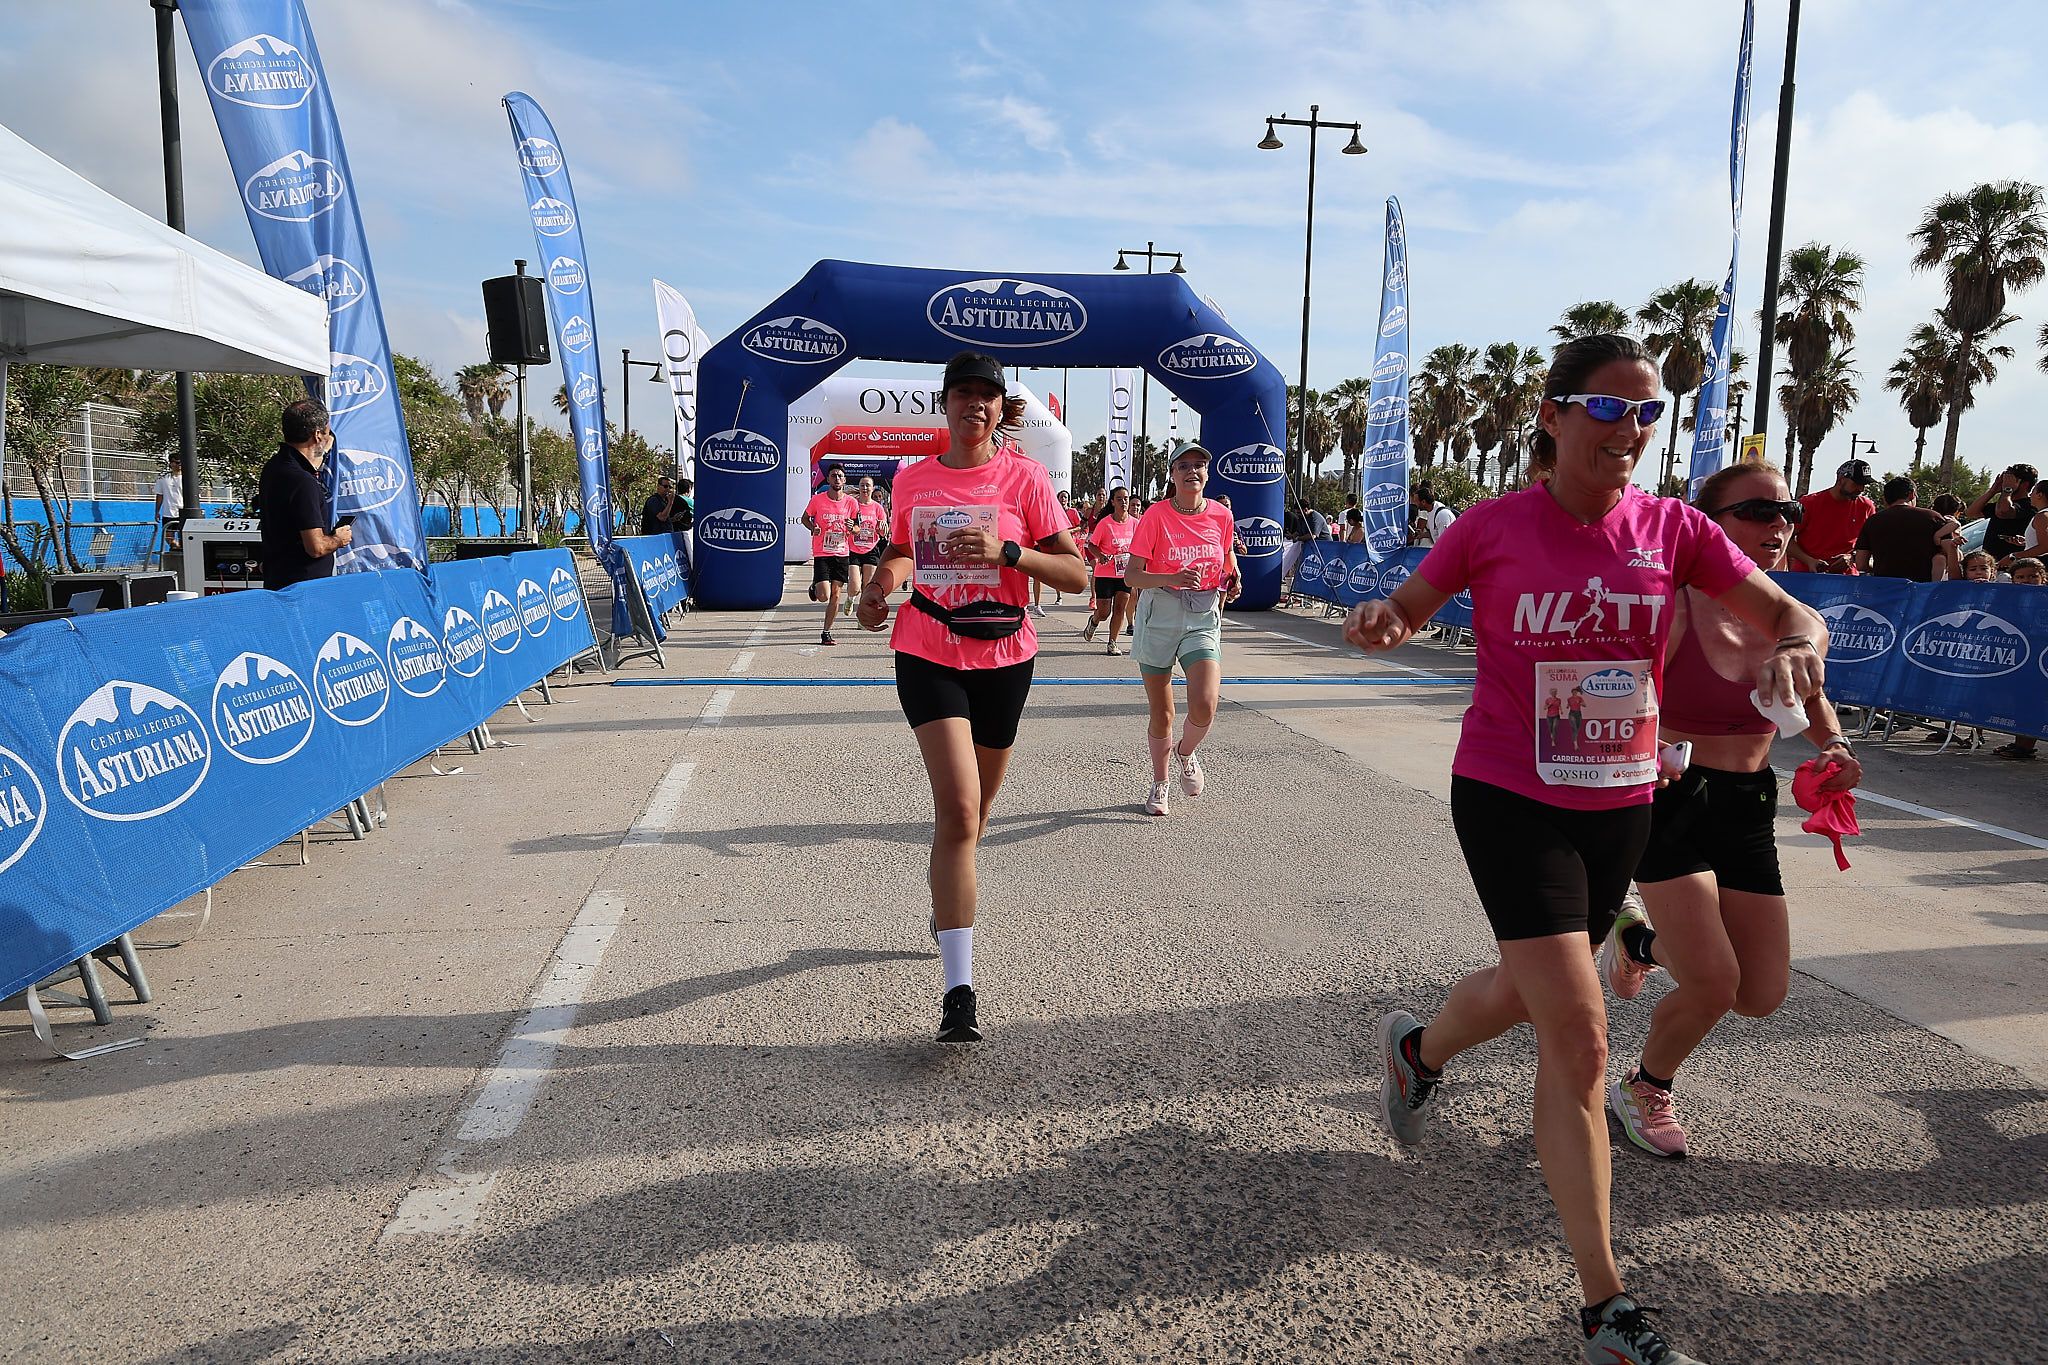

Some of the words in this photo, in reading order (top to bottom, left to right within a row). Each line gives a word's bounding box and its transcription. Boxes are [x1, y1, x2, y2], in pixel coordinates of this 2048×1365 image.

[965, 296, 1014, 306] CENTRAL
[1020, 299, 1070, 308] LECHERA
[939, 296, 1074, 331] ASTURIANA
[748, 331, 838, 354] ASTURIANA
[1182, 348, 1215, 356] CENTRAL
[1166, 352, 1252, 368] ASTURIANA
[834, 430, 866, 442] Sports
[882, 431, 934, 442] Santander
[704, 444, 776, 464] ASTURIANA
[1048, 470, 1068, 479] SHO
[913, 490, 942, 502] OYSHO
[702, 522, 774, 542] ASTURIANA
[1908, 630, 2016, 666] ASTURIANA
[1933, 630, 1974, 640] CENTRAL
[1976, 634, 2018, 646] LECHERA
[328, 664, 352, 678] CENTRAL
[354, 656, 376, 671] LECHERA
[232, 690, 266, 708] CENTRAL
[267, 681, 298, 698] LECHERA
[322, 668, 386, 710] ASTURIANA
[222, 694, 312, 748] ASTURIANA
[1584, 719, 1634, 740] 016
[90, 726, 142, 751] CENTRAL
[143, 713, 188, 735] LECHERA
[74, 730, 206, 802] ASTURIANA
[1552, 754, 1584, 763] CARRERA
[1552, 768, 1598, 780] OYSHO
